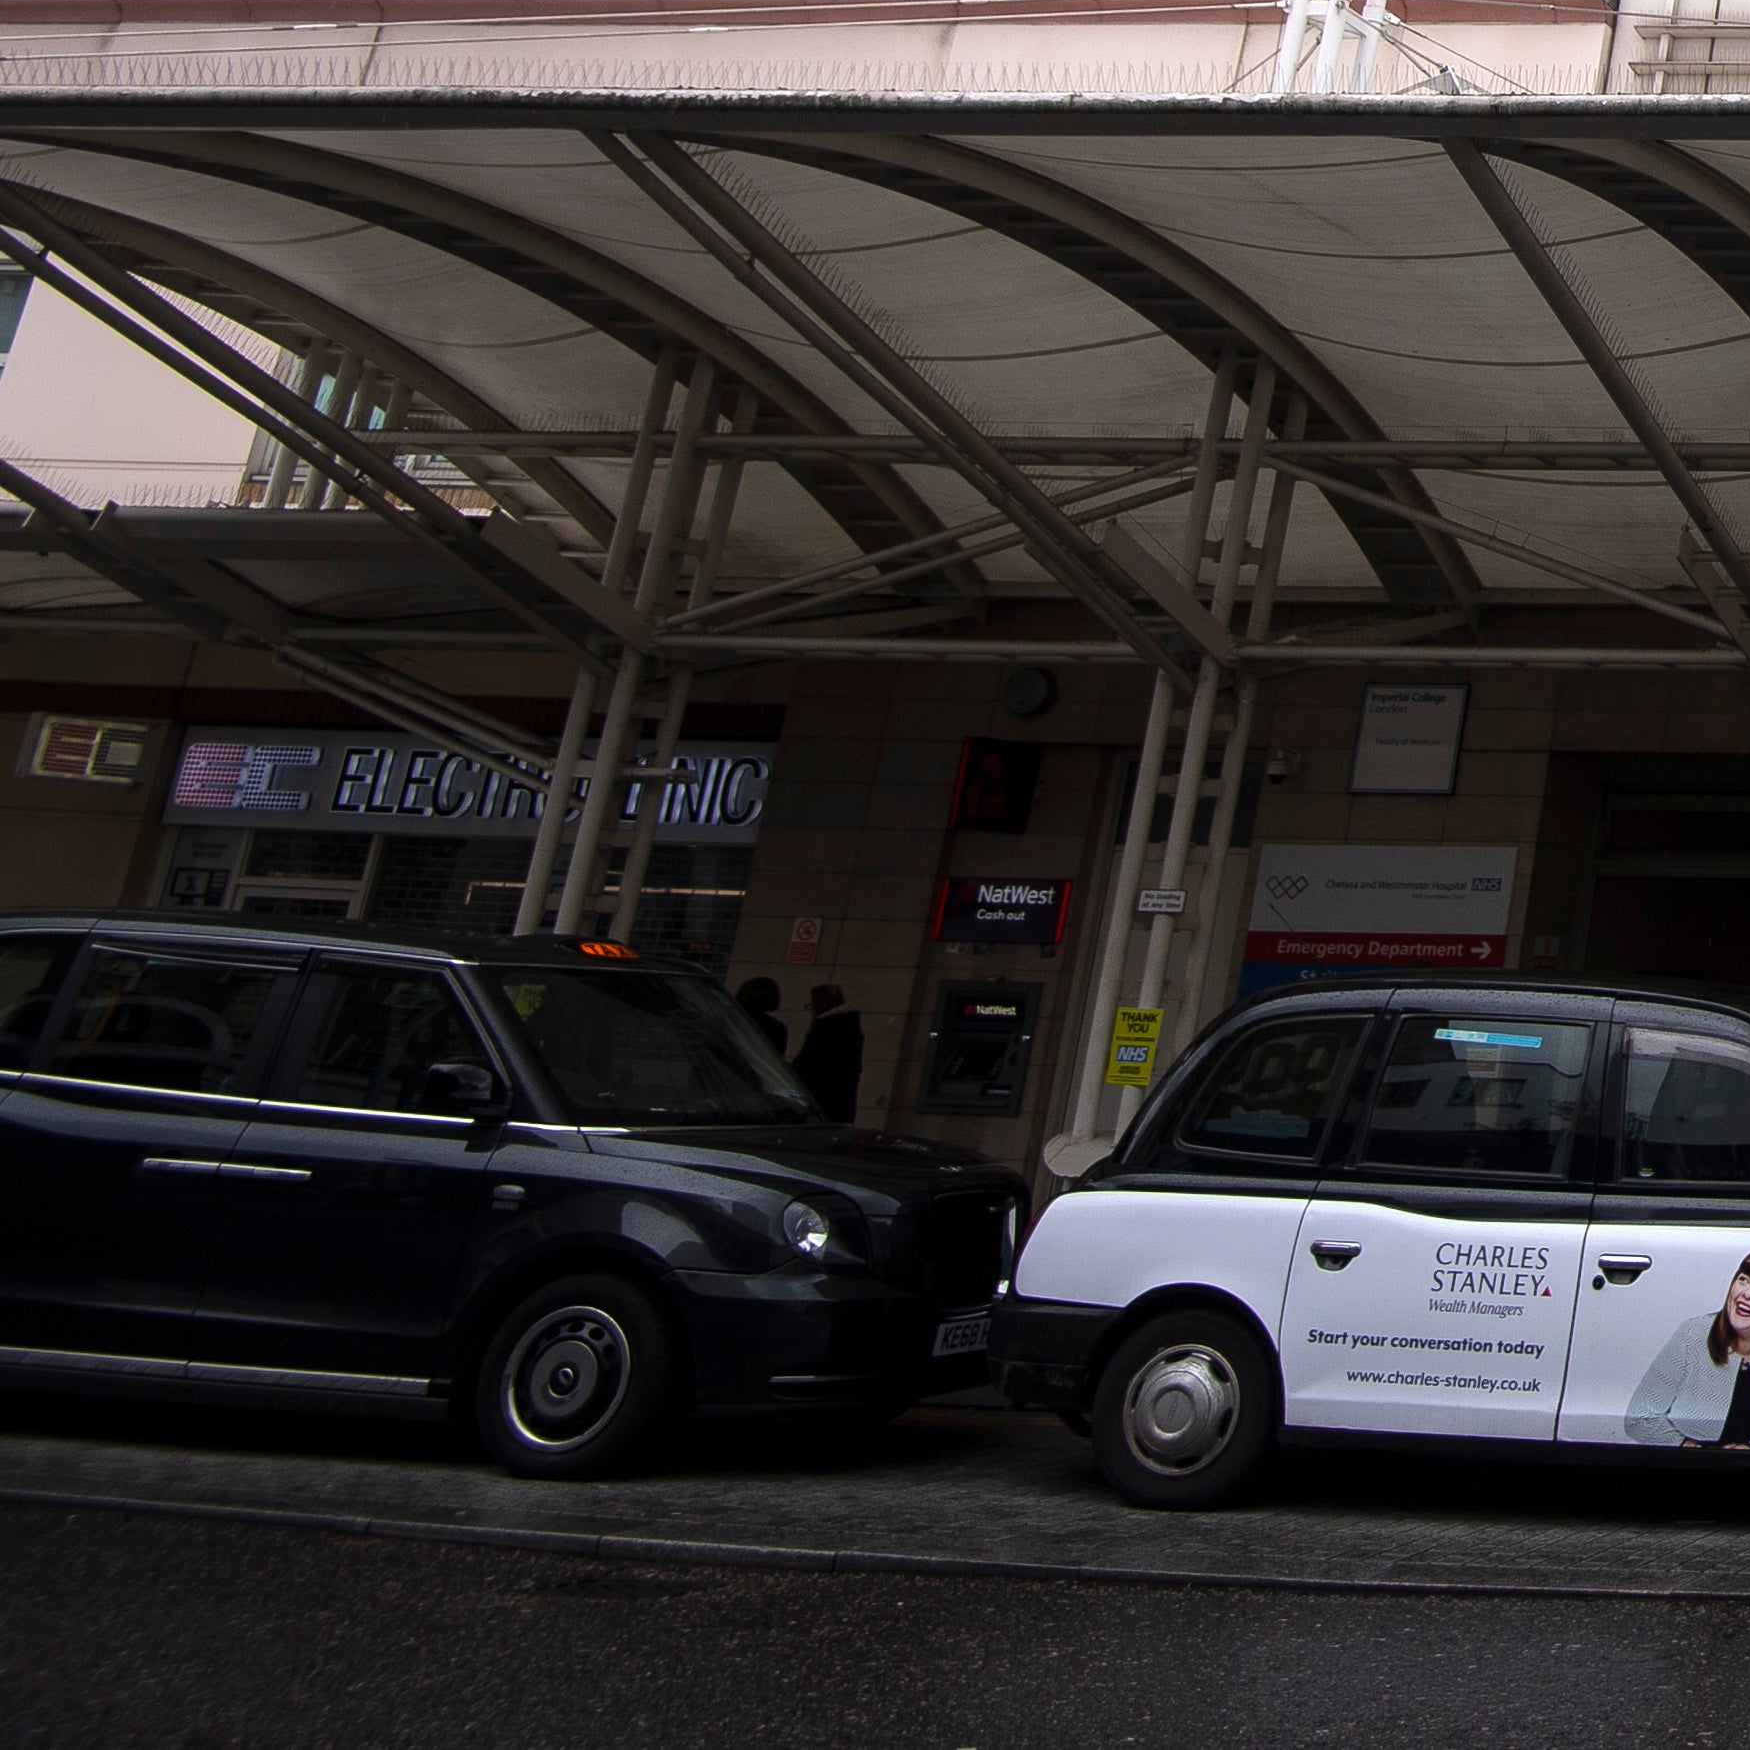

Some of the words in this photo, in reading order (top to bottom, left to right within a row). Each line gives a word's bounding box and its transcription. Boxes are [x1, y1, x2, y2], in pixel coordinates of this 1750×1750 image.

[1369, 704, 1408, 713] London
[1371, 692, 1410, 703] Imperial
[1411, 693, 1446, 705] College
[174, 743, 323, 810] EC
[977, 884, 1056, 905] NatWest
[1325, 879, 1357, 890] Chelsea
[1359, 880, 1376, 890] and
[1377, 880, 1431, 891] Westminster
[1433, 881, 1468, 892] Hospital
[1472, 879, 1501, 891] NHS
[977, 908, 1005, 921] Cash
[1007, 911, 1026, 921] out
[1277, 939, 1362, 958] Emergency
[1368, 940, 1464, 959] Department
[976, 1004, 1018, 1016] NatWest
[1121, 1012, 1158, 1022] THANK
[1127, 1023, 1150, 1033] YOU
[1117, 1045, 1148, 1061] NHS
[1436, 1242, 1550, 1270] CHARLES
[1430, 1269, 1546, 1297] STANLEY
[1428, 1298, 1467, 1314] Wealth
[1468, 1301, 1525, 1319] Managers
[940, 1323, 979, 1350] KE68
[1308, 1328, 1348, 1345] Start
[1351, 1332, 1388, 1349] your
[1390, 1335, 1493, 1353] conversation
[1497, 1340, 1545, 1359] today
[1347, 1370, 1541, 1393] www.charles-stanley.co.uk
